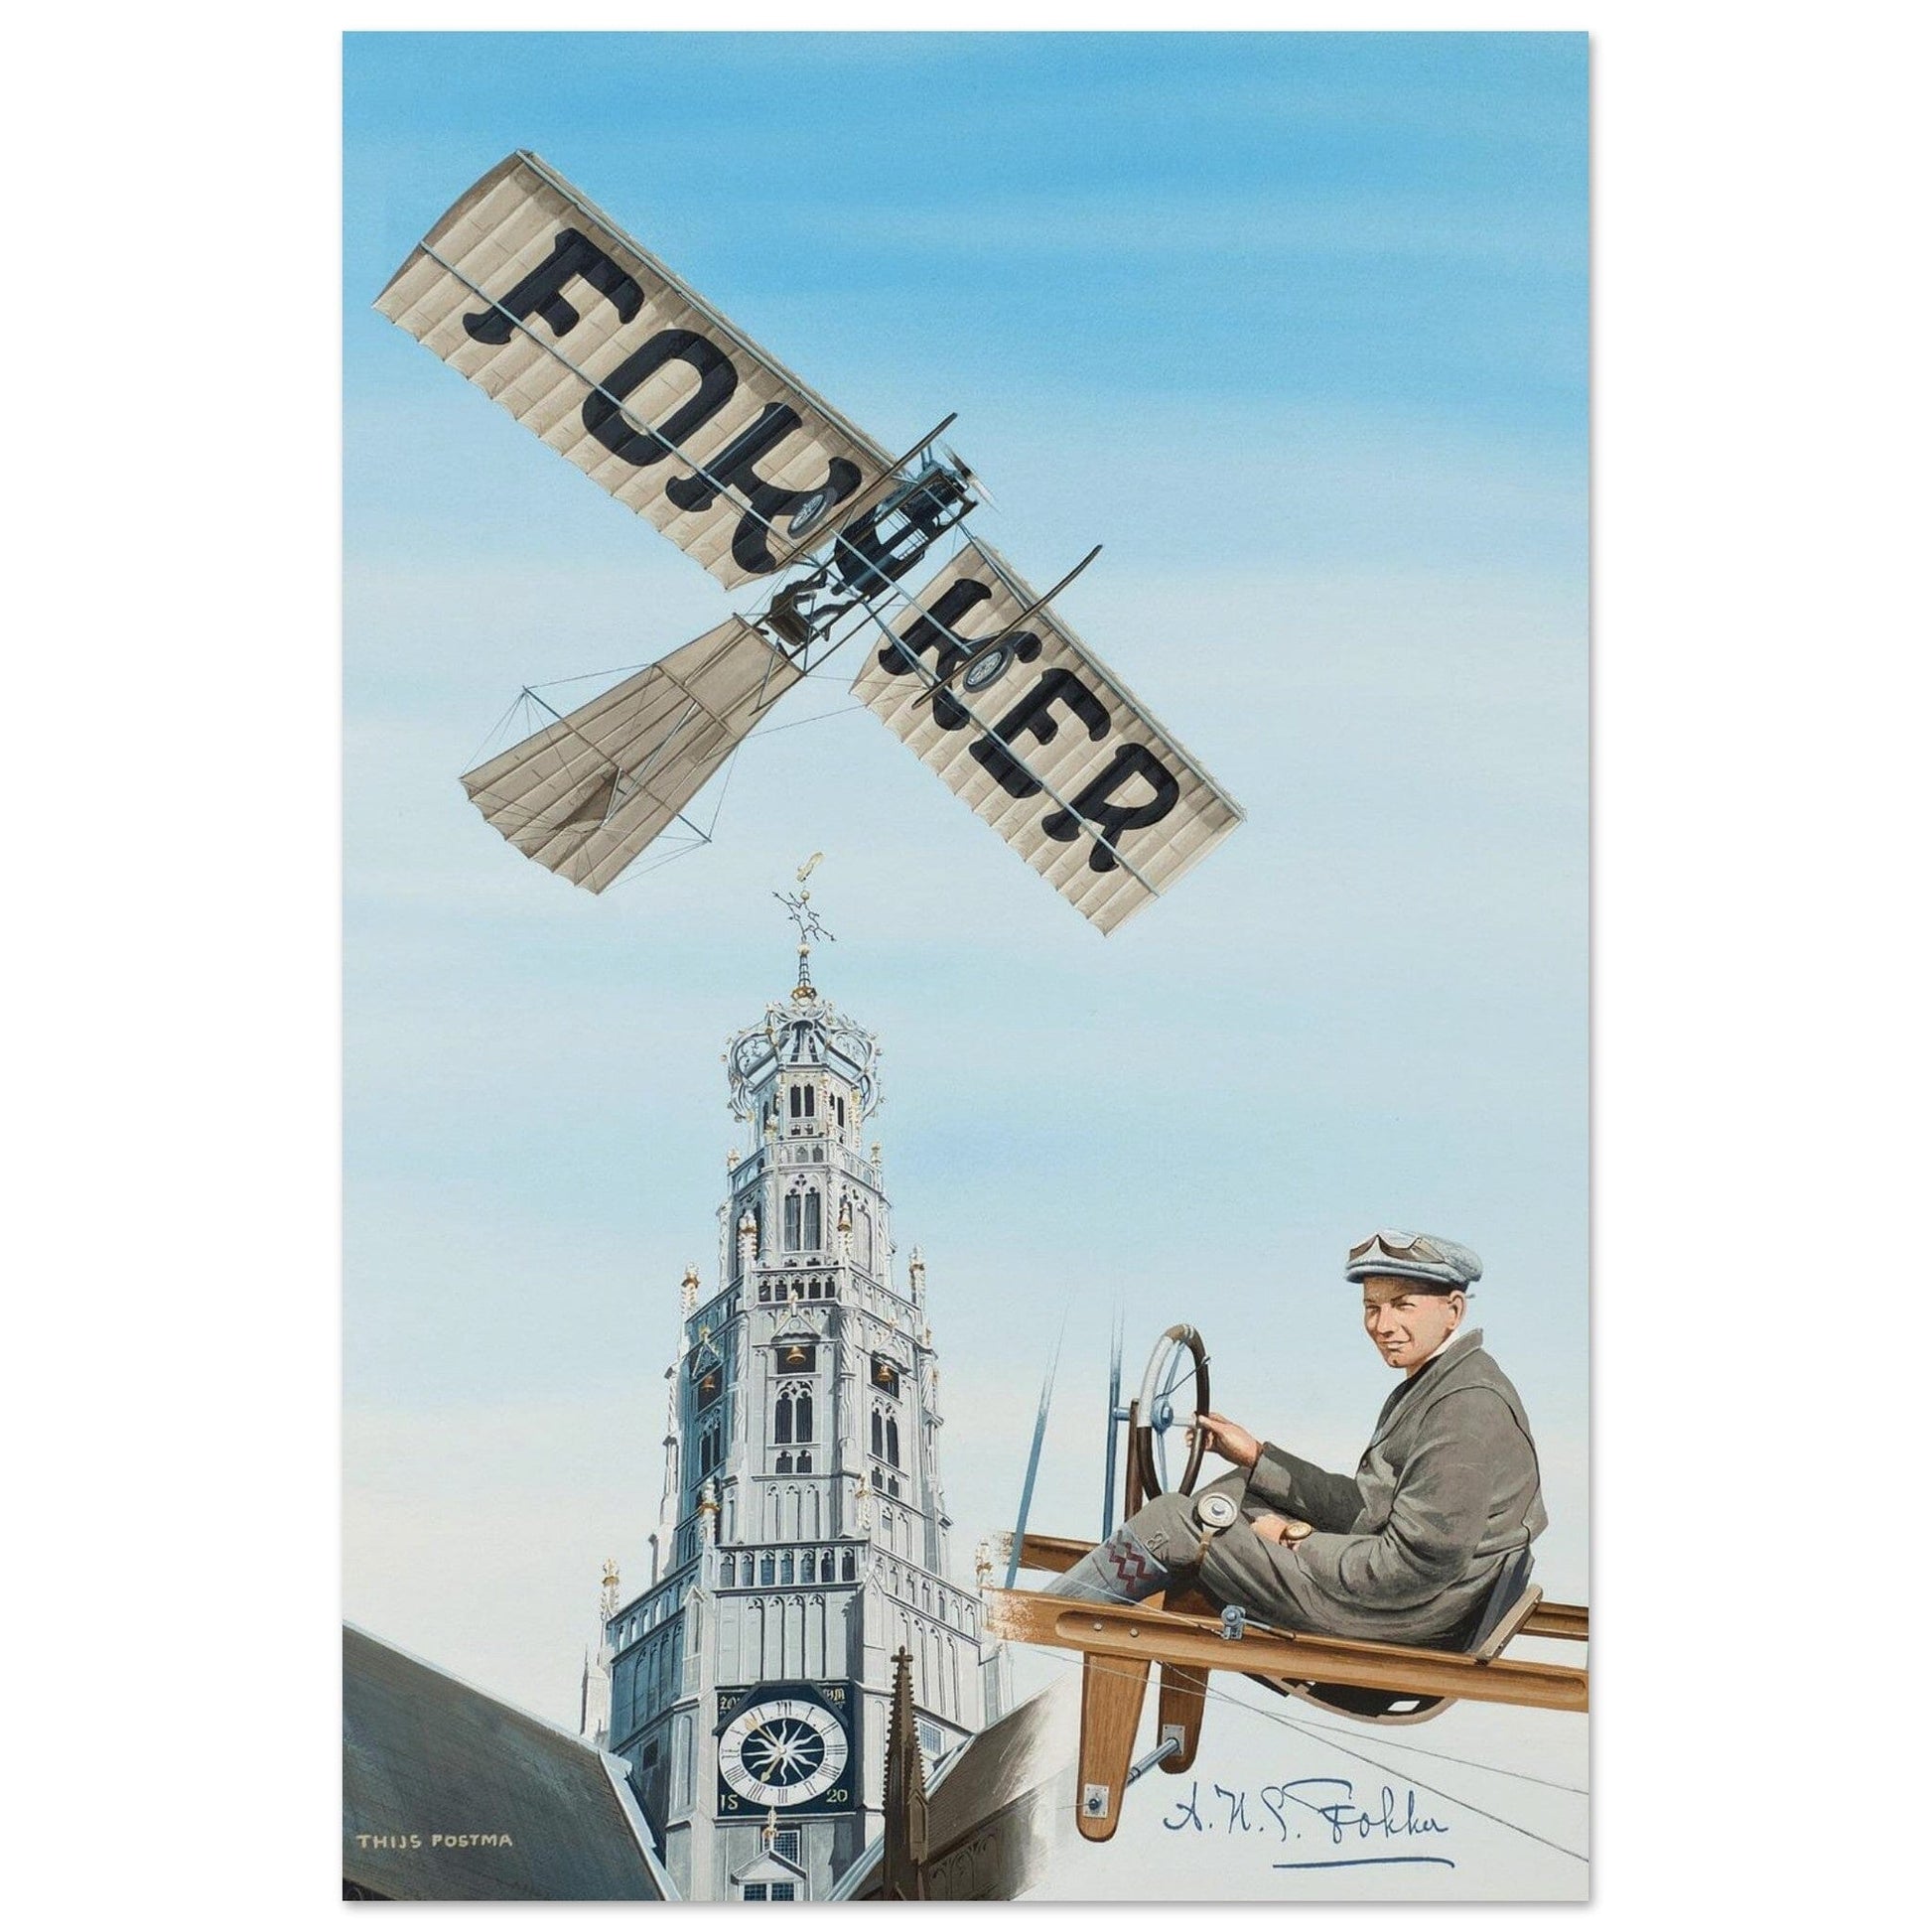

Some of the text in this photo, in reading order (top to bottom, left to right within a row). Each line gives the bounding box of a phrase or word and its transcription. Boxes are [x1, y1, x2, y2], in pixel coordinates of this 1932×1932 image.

[826, 1789, 848, 1803] 20
[355, 1834, 513, 1850] THIJS POSTMA
